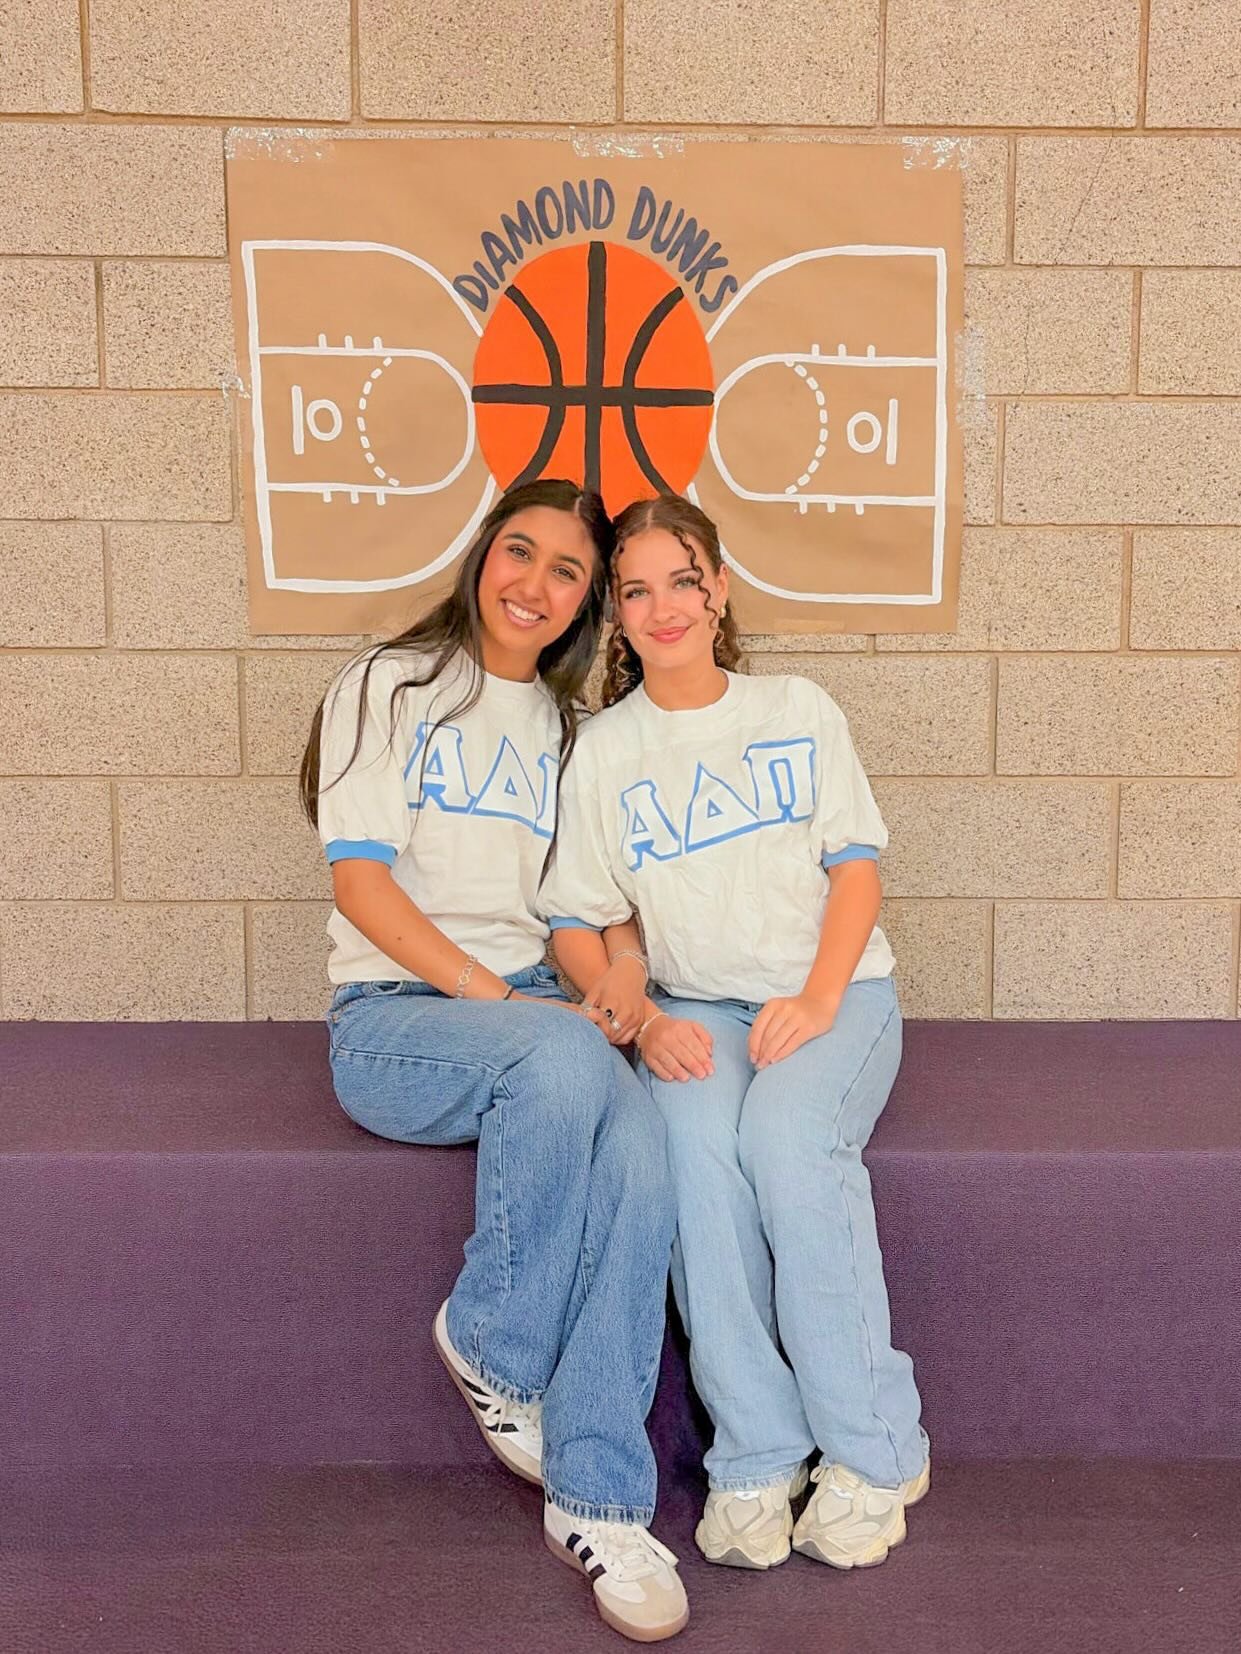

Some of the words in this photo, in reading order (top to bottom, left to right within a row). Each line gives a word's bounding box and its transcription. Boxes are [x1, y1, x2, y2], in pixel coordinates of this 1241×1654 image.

[453, 178, 615, 312] DIAMOND
[627, 186, 738, 313] DUNKS
[619, 737, 816, 873] ΑΔΠ
